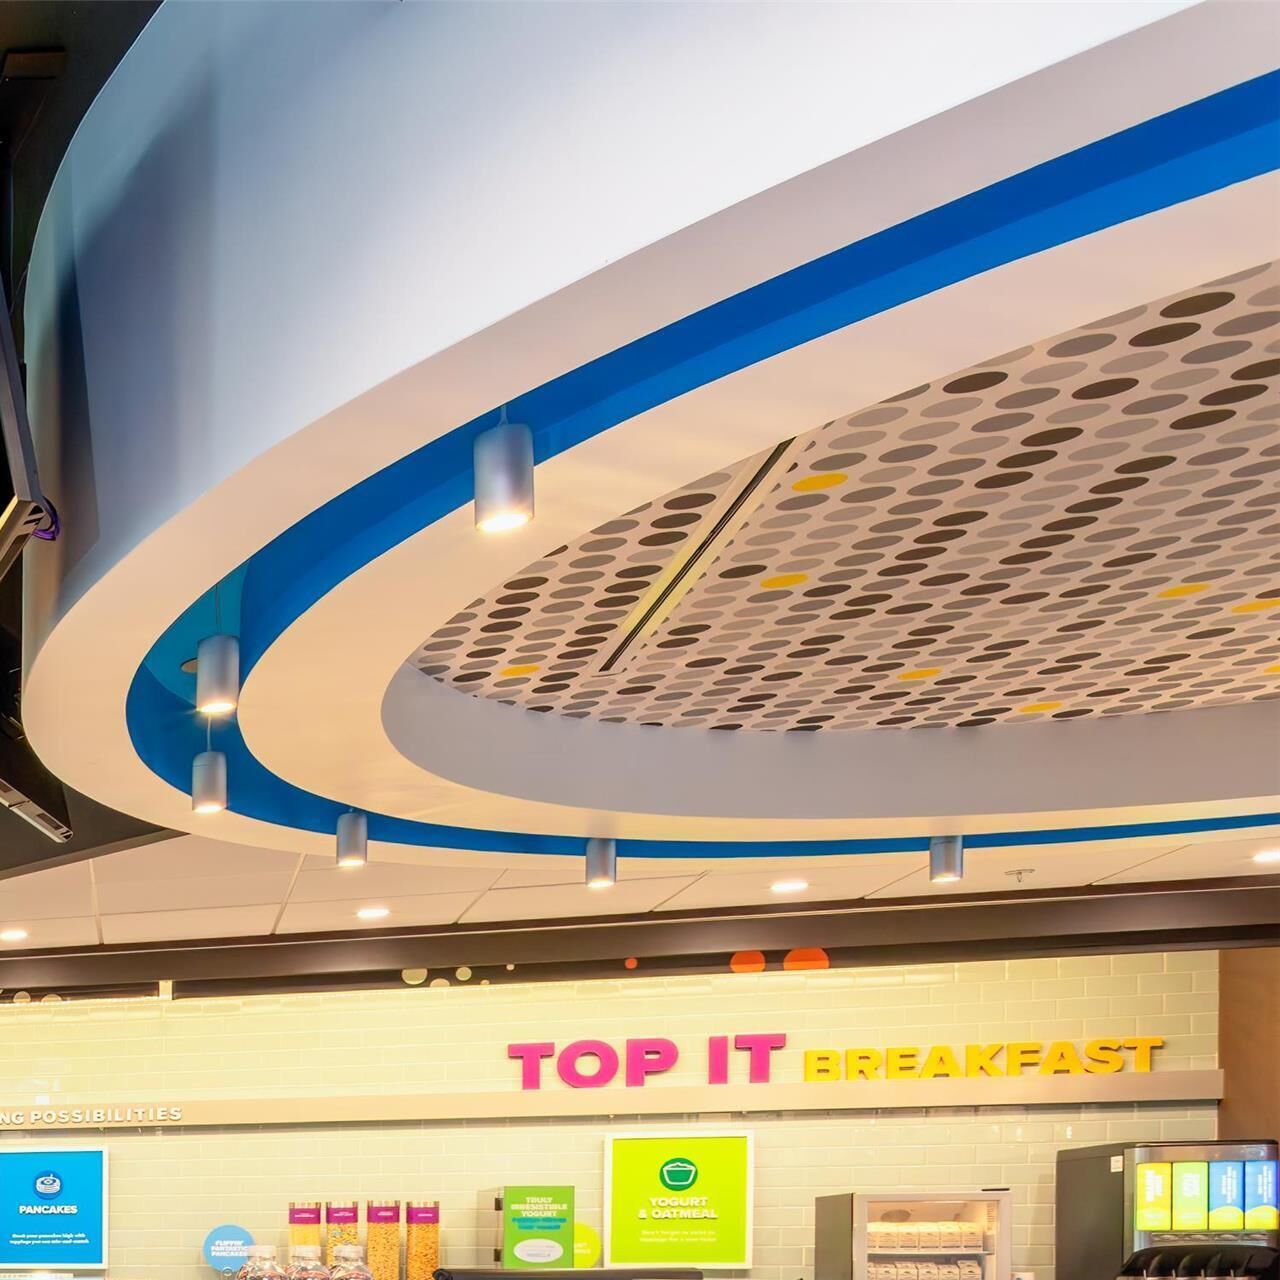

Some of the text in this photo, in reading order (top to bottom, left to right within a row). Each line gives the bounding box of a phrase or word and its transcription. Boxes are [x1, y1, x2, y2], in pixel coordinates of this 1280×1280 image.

[507, 1033, 1164, 1090] TOP IT BREAKFAST
[29, 1107, 183, 1124] POSSIBILITIES
[649, 1197, 708, 1207] YOGURT
[19, 1205, 78, 1215] PANCAKES
[652, 1209, 719, 1219] OATMEAL
